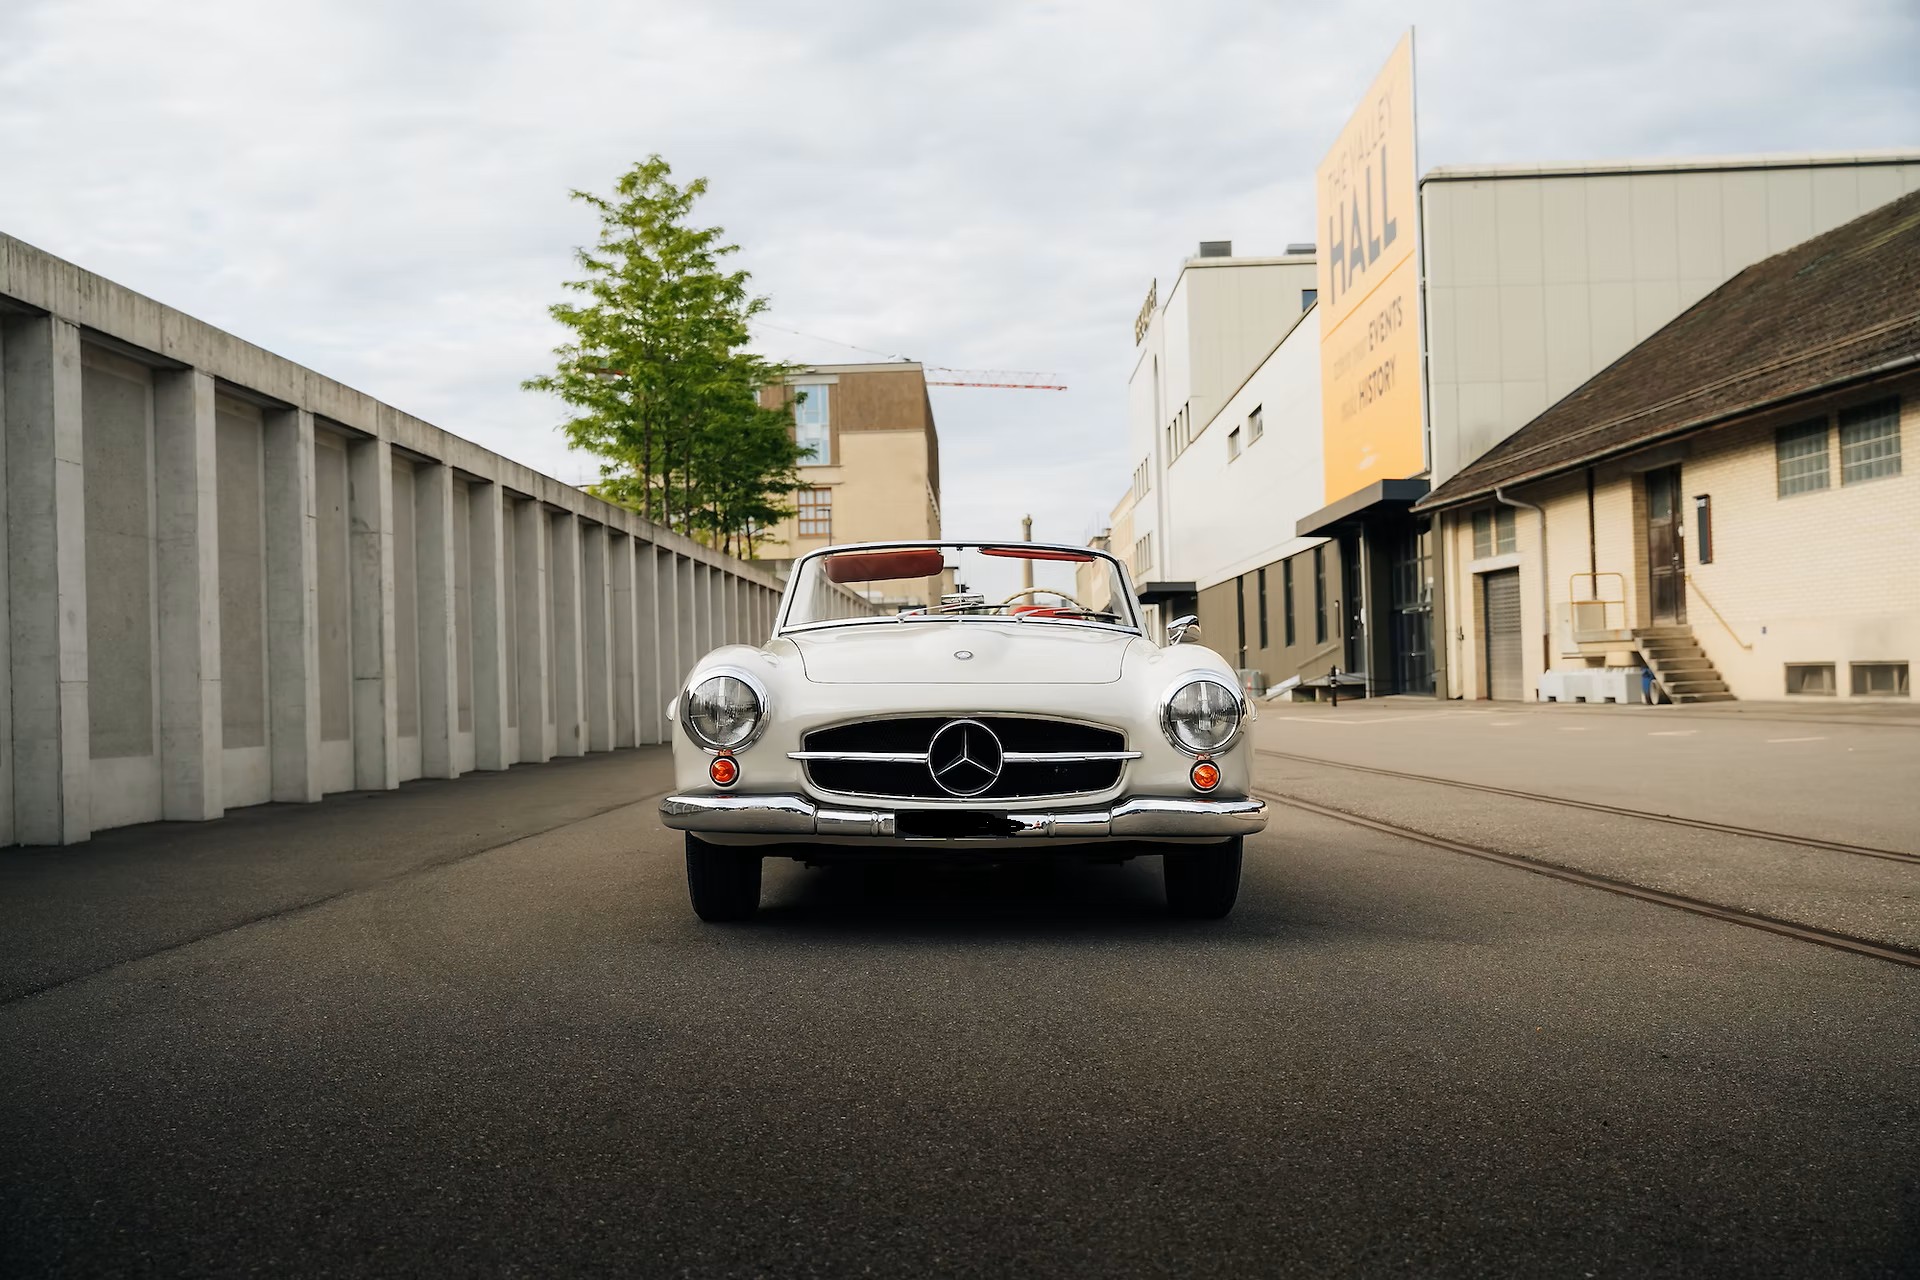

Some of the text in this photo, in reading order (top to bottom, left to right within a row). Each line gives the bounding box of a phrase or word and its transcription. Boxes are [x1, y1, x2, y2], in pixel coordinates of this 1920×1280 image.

[1327, 83, 1393, 208] THE VALLEY
[1330, 143, 1397, 306] HALL
[1369, 295, 1403, 352] EVENTS
[1359, 354, 1396, 411] HISTORY
